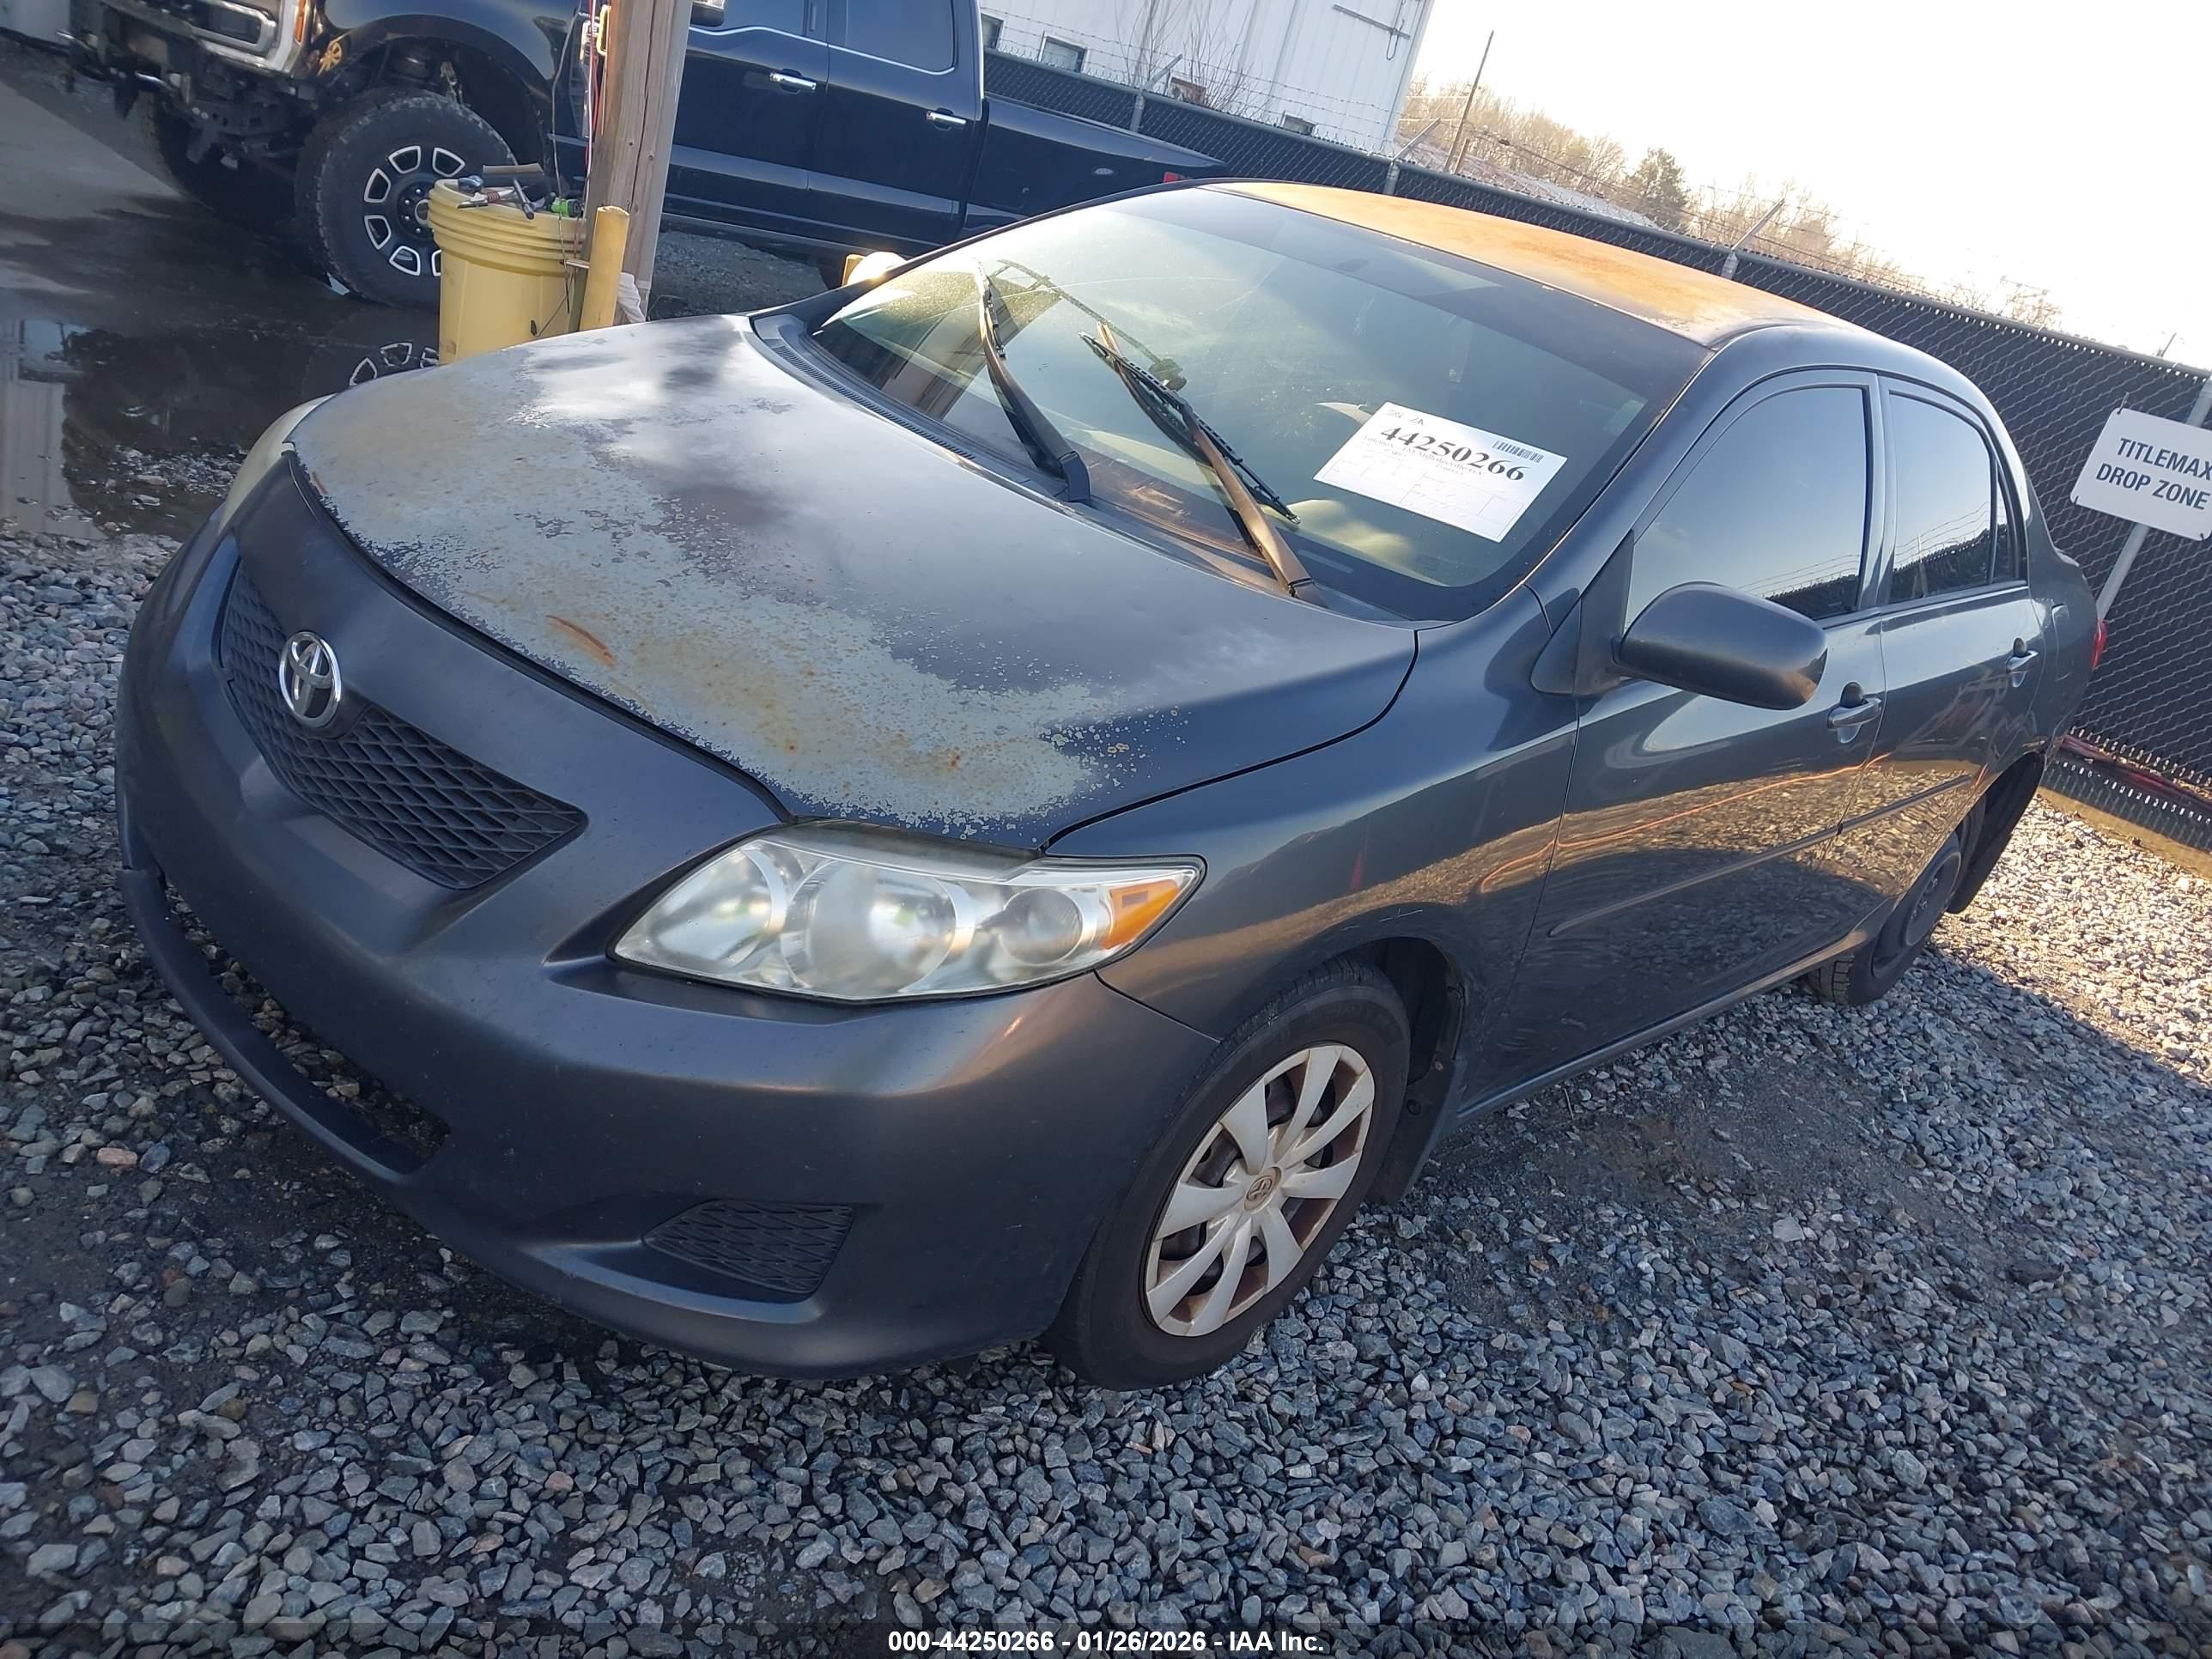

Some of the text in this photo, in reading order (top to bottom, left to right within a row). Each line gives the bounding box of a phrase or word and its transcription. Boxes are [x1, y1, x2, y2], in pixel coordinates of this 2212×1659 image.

[1381, 428, 1530, 481] 44250266
[2117, 438, 2212, 481] TITLEMAX
[2096, 463, 2211, 510] DROP ZONE
